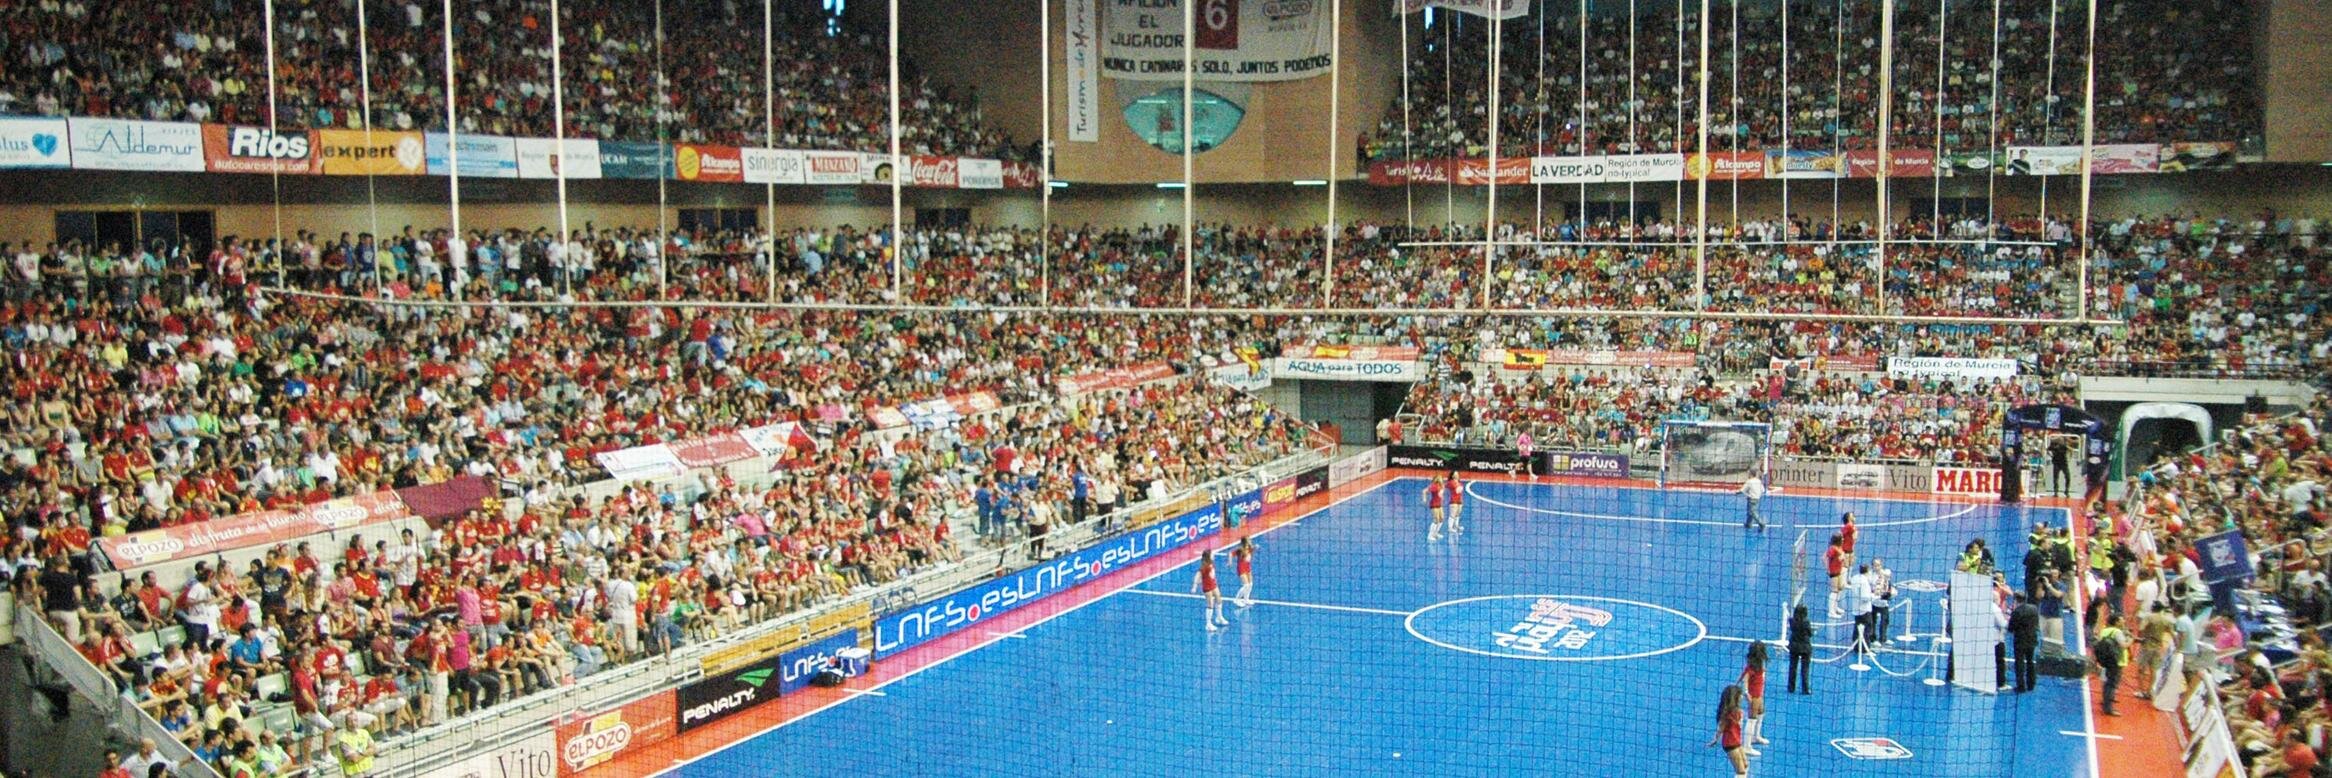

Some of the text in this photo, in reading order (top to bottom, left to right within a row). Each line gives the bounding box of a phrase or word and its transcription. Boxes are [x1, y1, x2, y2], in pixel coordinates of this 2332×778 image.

[1138, 14, 1159, 28] EL
[1111, 34, 1185, 48] JUGADOR
[1103, 57, 1136, 73] NUNCA
[1140, 59, 1198, 74] CAMINARS
[1236, 60, 1279, 74] JUNTOS
[1284, 54, 1331, 73] PODEMOS
[231, 126, 308, 159] Rios
[323, 144, 397, 160] expert
[748, 151, 798, 177] sinrgia
[1532, 163, 1604, 177] LA VERDAD
[1608, 158, 1638, 168] Región
[1639, 158, 1651, 167] de
[1714, 158, 1761, 169] Alcampo
[1474, 166, 1529, 178] Sanander
[1288, 361, 1325, 373] AGUA
[1355, 363, 1402, 374] TODOS
[1893, 358, 2011, 369] Región de Murcia
[1570, 456, 1618, 471] profusa
[1889, 469, 1927, 490] Vito
[496, 748, 551, 778] Vito
